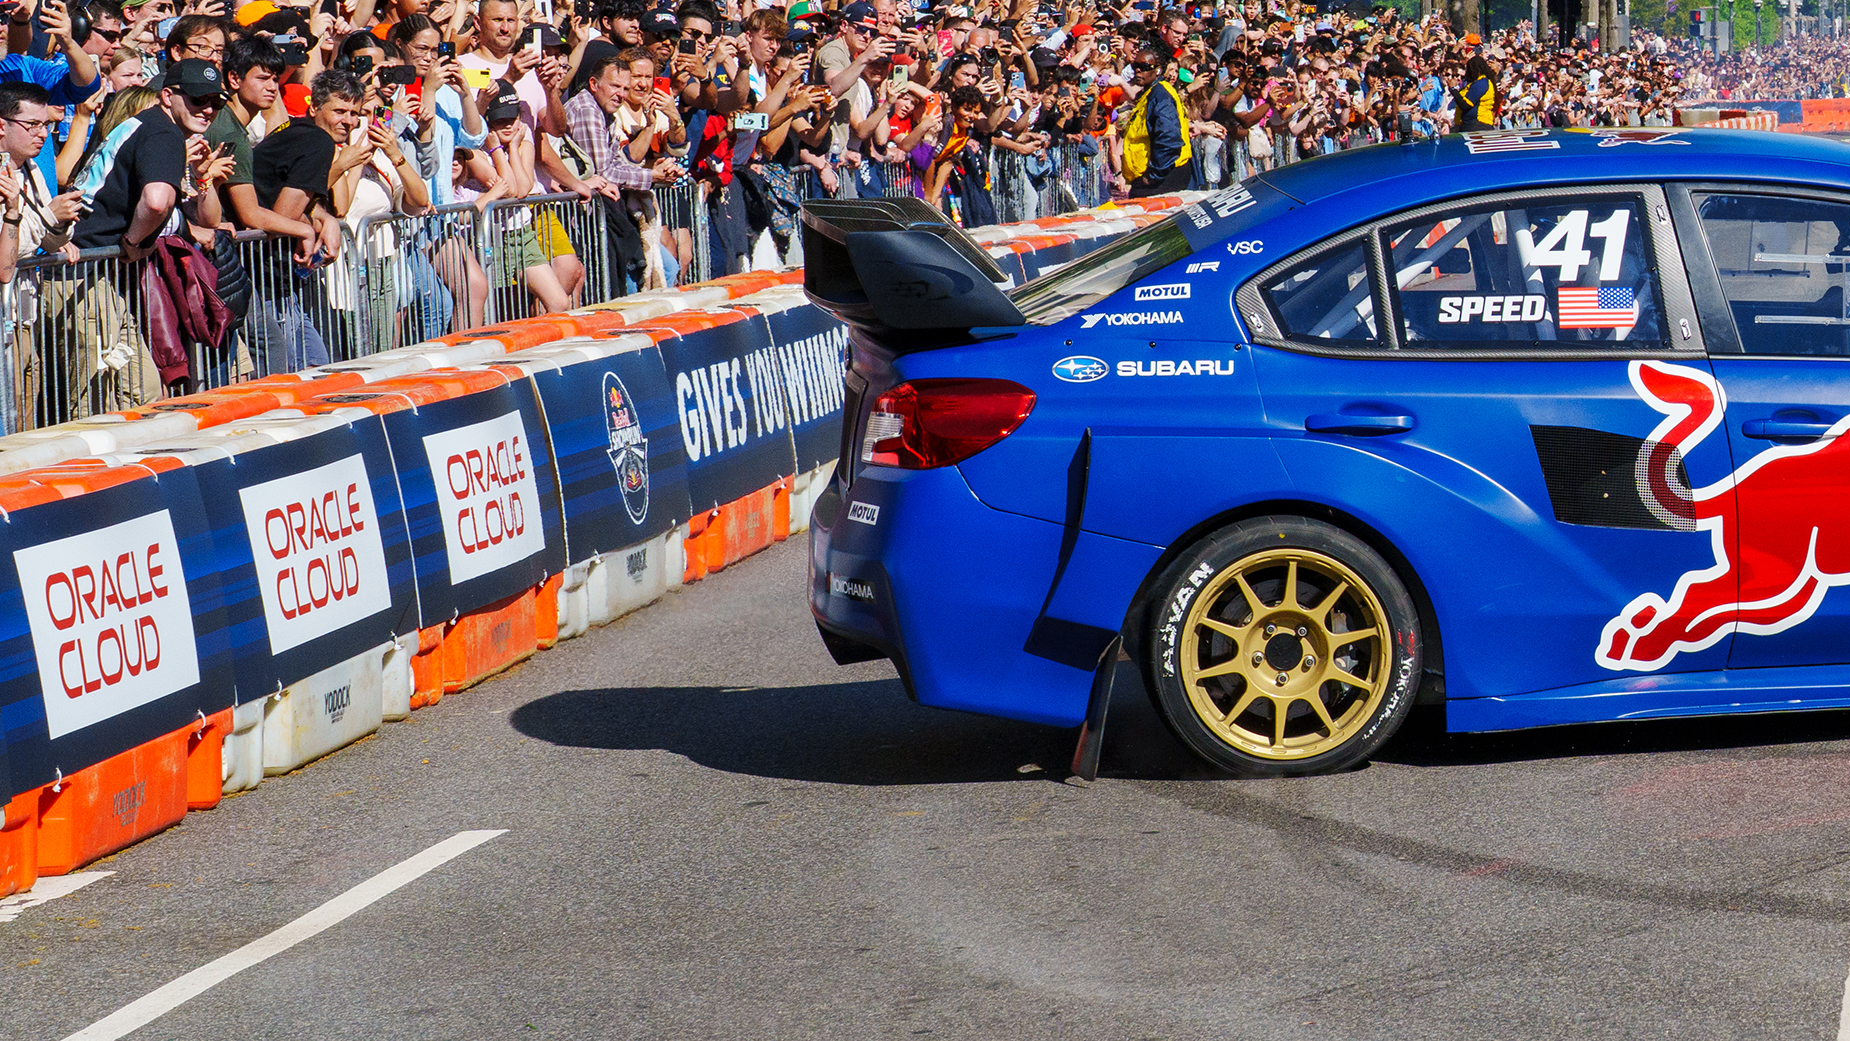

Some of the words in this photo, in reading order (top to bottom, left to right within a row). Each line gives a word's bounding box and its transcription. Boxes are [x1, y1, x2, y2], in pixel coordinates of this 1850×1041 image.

[1529, 209, 1630, 282] 41
[1105, 311, 1184, 326] YOKOHAMA
[1138, 286, 1188, 298] MOTUL
[1438, 295, 1546, 323] SPEED
[1117, 360, 1235, 376] SUBARU
[676, 357, 748, 462] GIVES
[744, 346, 785, 438] YOU
[446, 436, 525, 500] ORACLE
[265, 483, 364, 560] ORACLE
[458, 492, 524, 554] CLOUD
[850, 504, 877, 522] MOTUL
[45, 542, 169, 630] ORACLE
[277, 547, 359, 620] CLOUD
[59, 615, 161, 699] CLOUD
[324, 684, 351, 716] YODOCK
[113, 780, 147, 817] YODOCK
